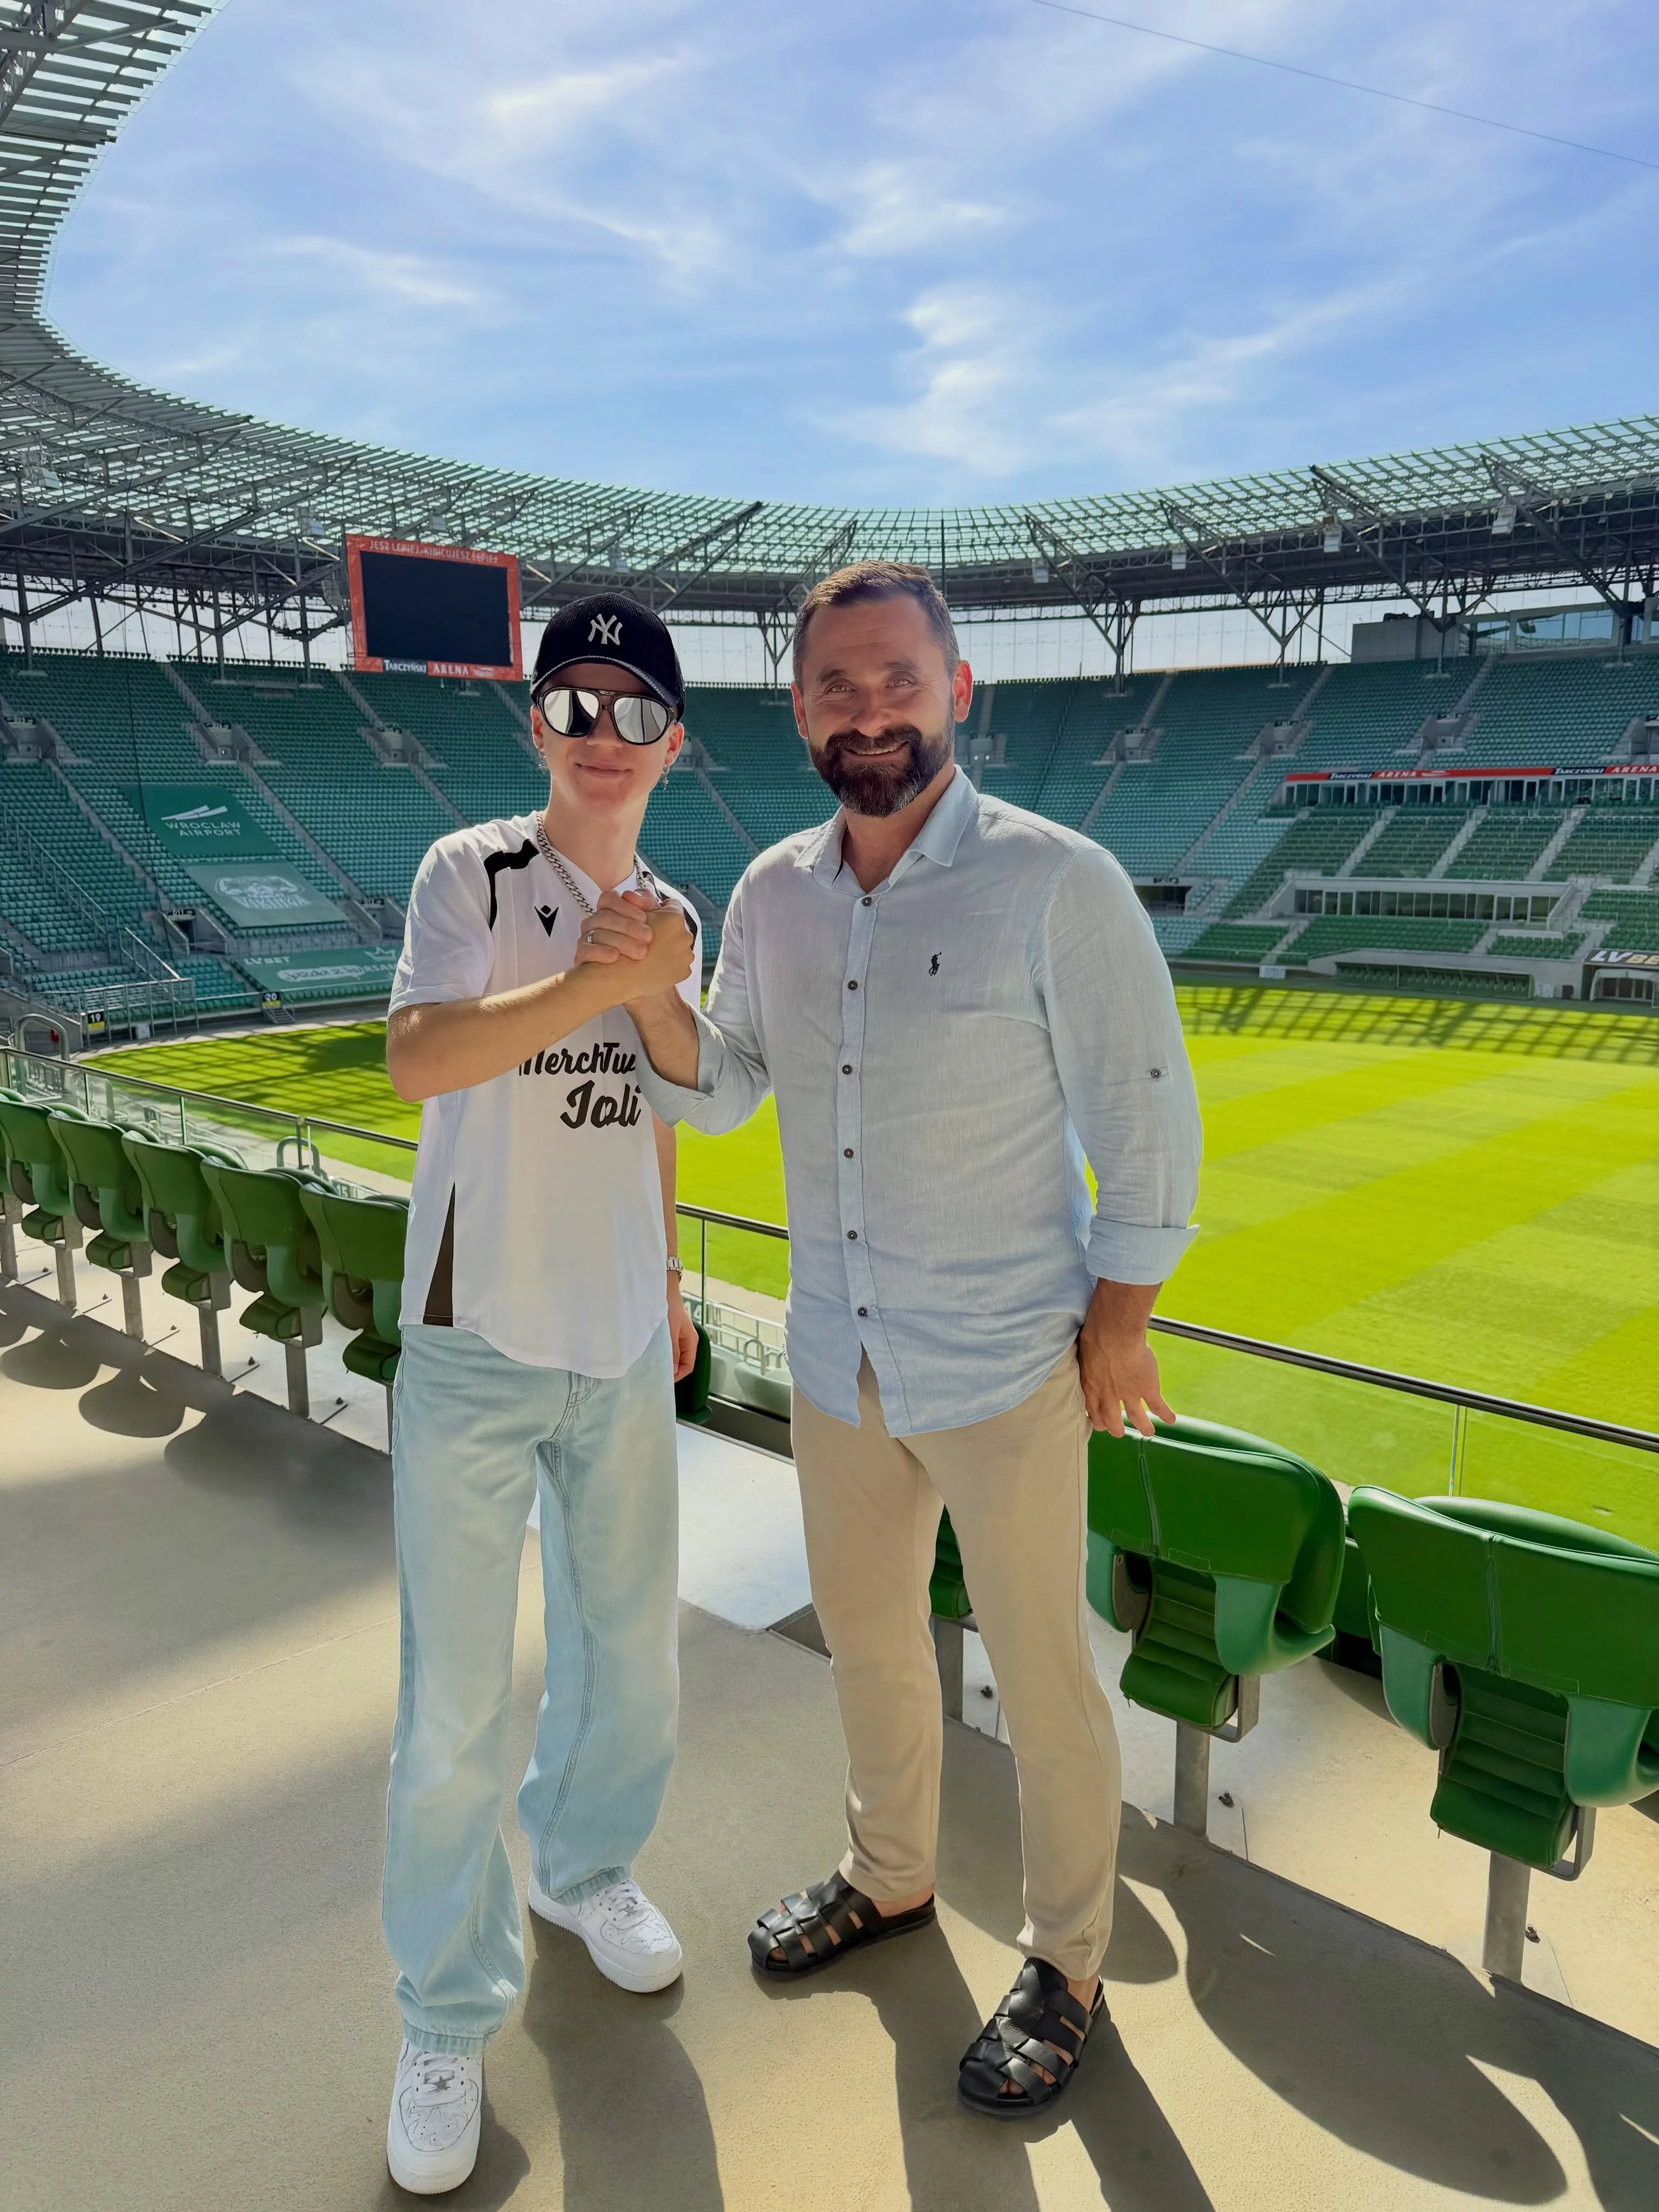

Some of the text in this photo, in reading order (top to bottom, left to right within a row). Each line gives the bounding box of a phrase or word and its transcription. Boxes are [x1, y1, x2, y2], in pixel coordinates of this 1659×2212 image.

[369, 540, 390, 551] JESZ
[588, 613, 623, 645] NY
[433, 664, 469, 676] ARENA
[90, 1013, 101, 1023] 19
